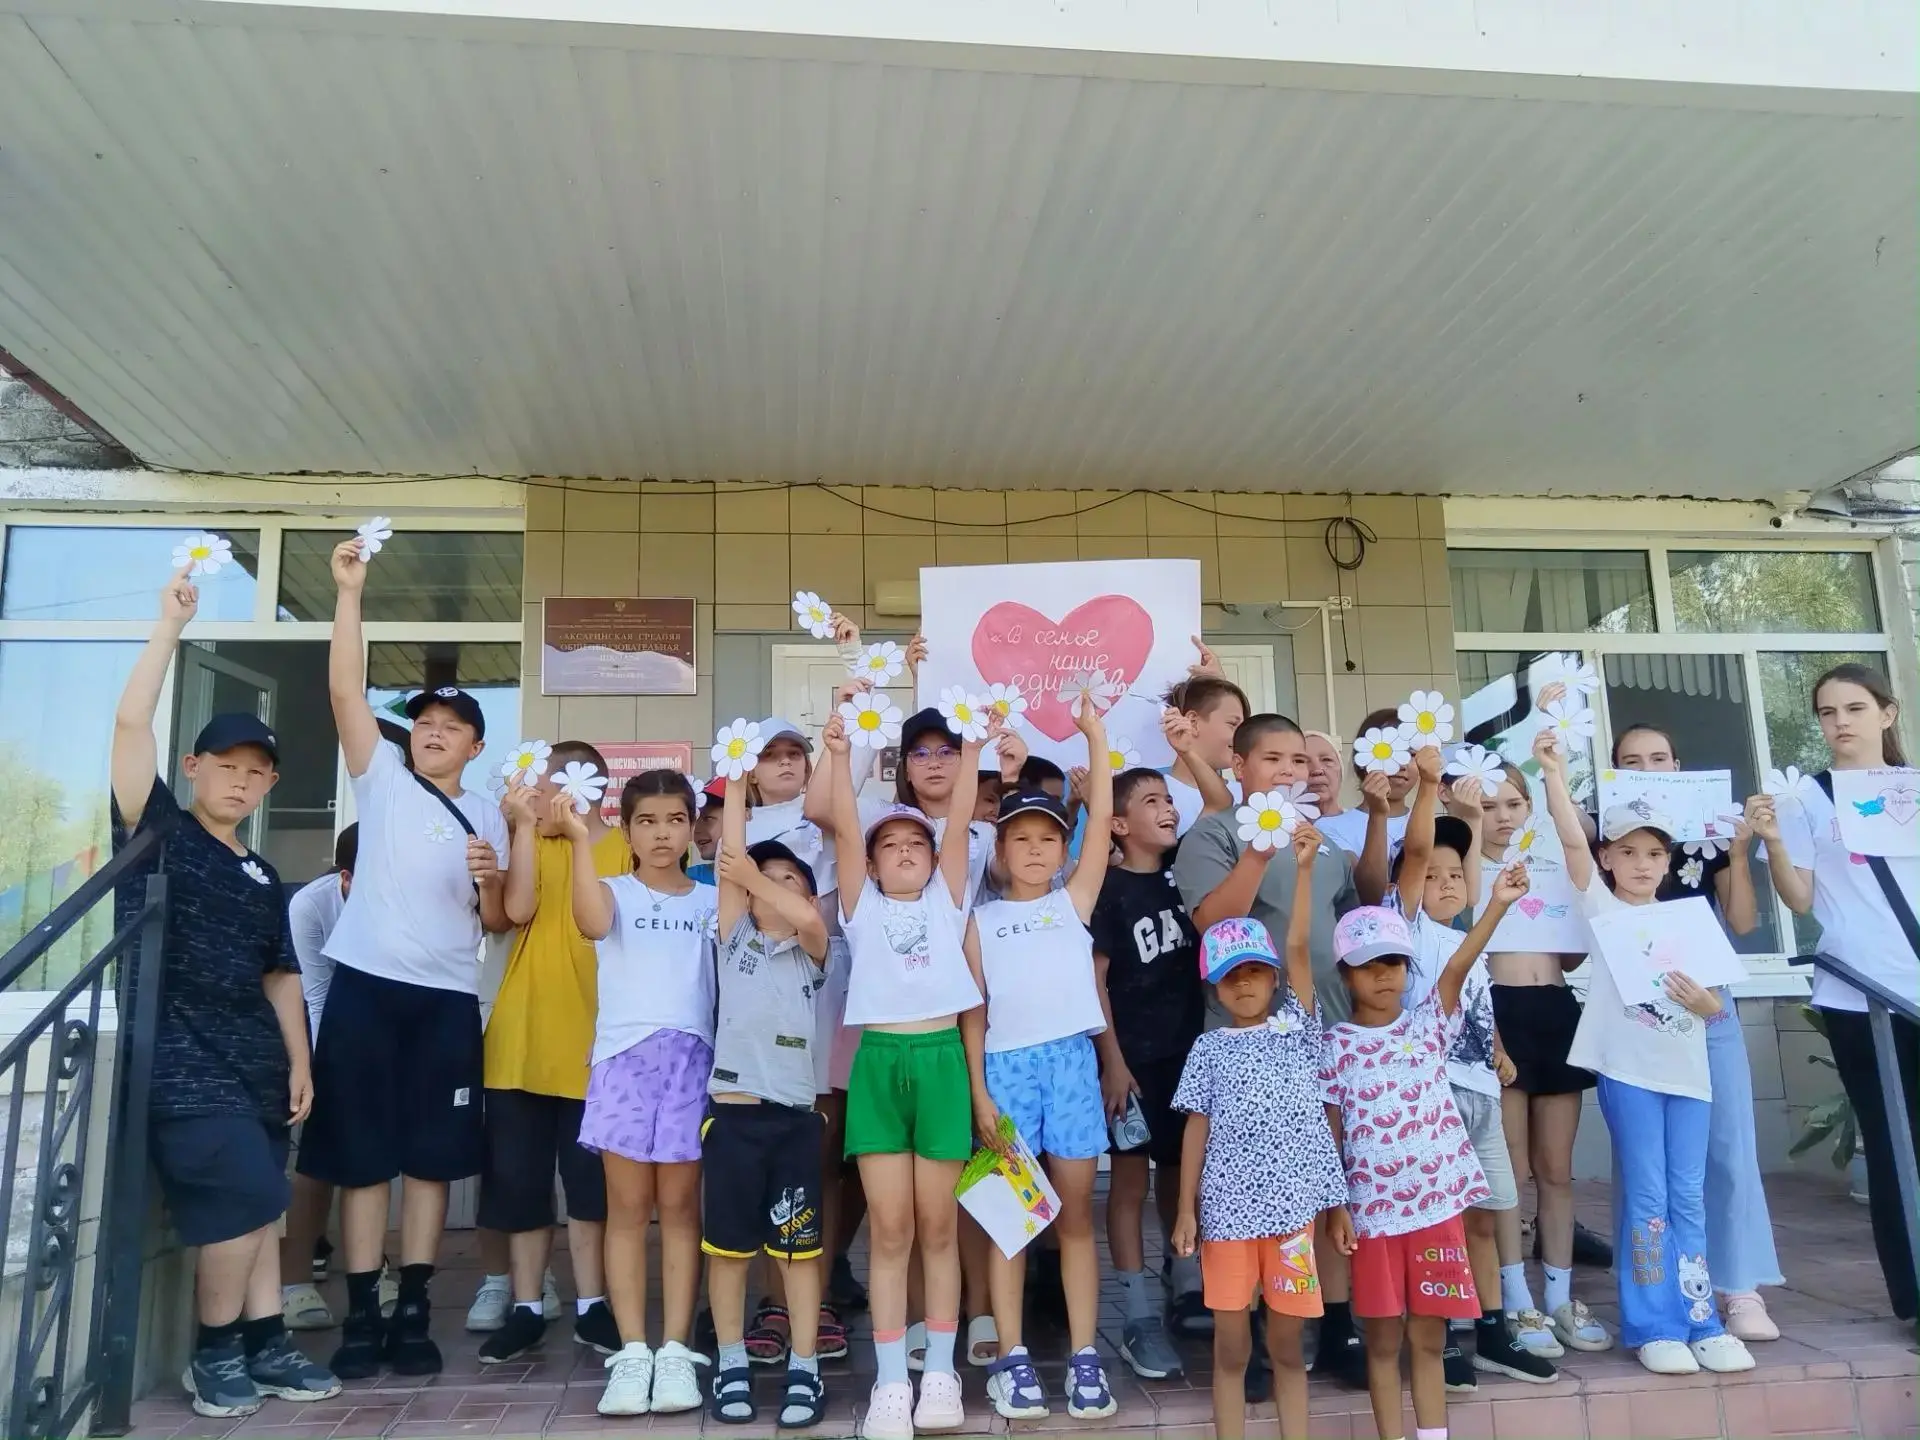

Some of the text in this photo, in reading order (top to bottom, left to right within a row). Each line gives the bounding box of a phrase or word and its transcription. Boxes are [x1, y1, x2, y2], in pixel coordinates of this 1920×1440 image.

[1034, 629, 1099, 647] семье
[1048, 653, 1109, 672] наше
[606, 755, 683, 770] ОНСУЛЬТАЦИОННЫЙ
[634, 917, 700, 934] CELIN
[1133, 904, 1187, 964] GA
